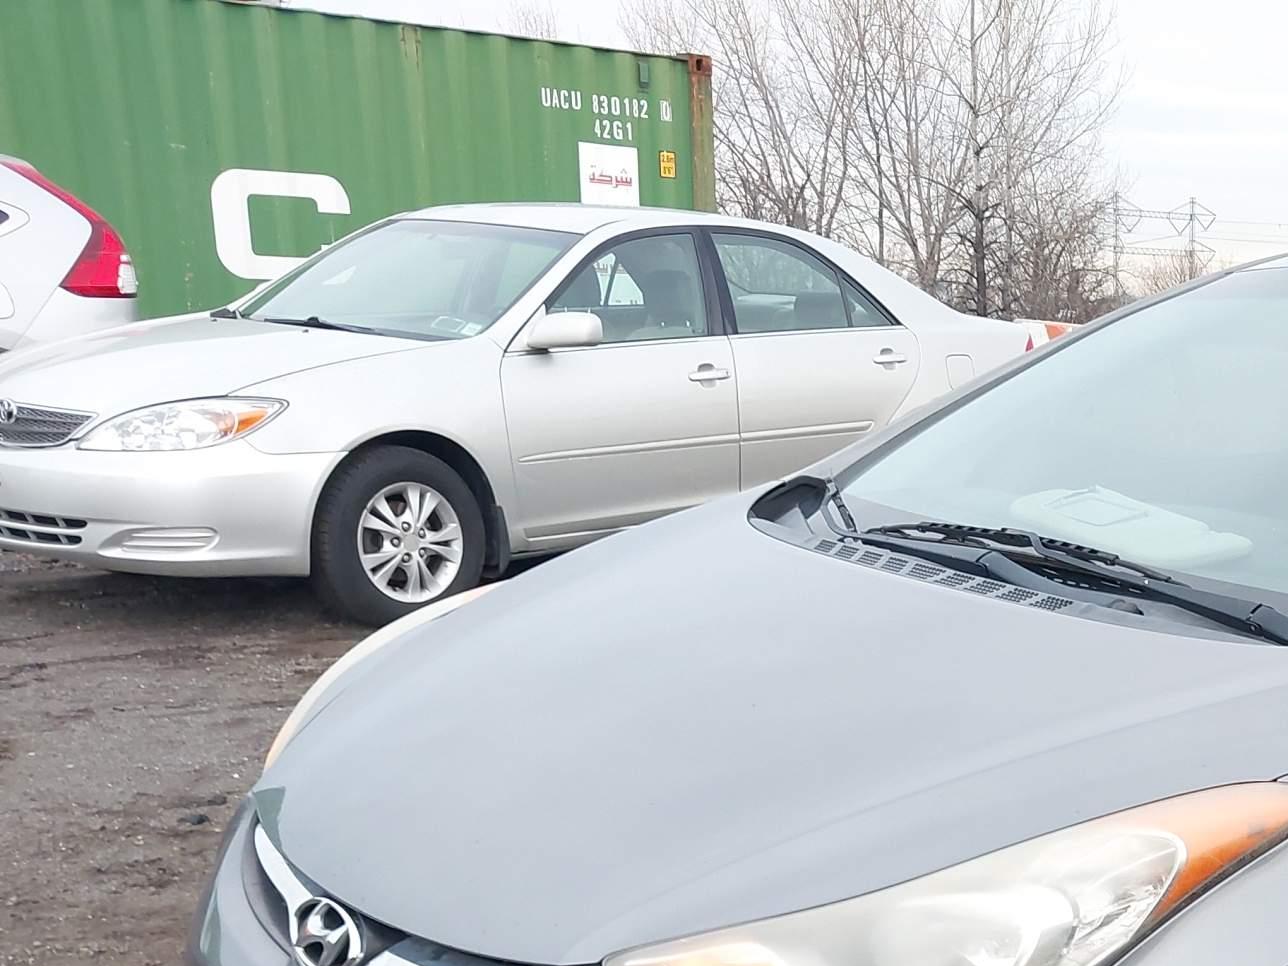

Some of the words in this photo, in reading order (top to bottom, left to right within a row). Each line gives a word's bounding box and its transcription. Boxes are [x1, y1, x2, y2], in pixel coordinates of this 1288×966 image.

[541, 87, 582, 110] UACU
[592, 94, 649, 119] 830182
[594, 119, 633, 140] 42G1
[210, 168, 352, 280] C
